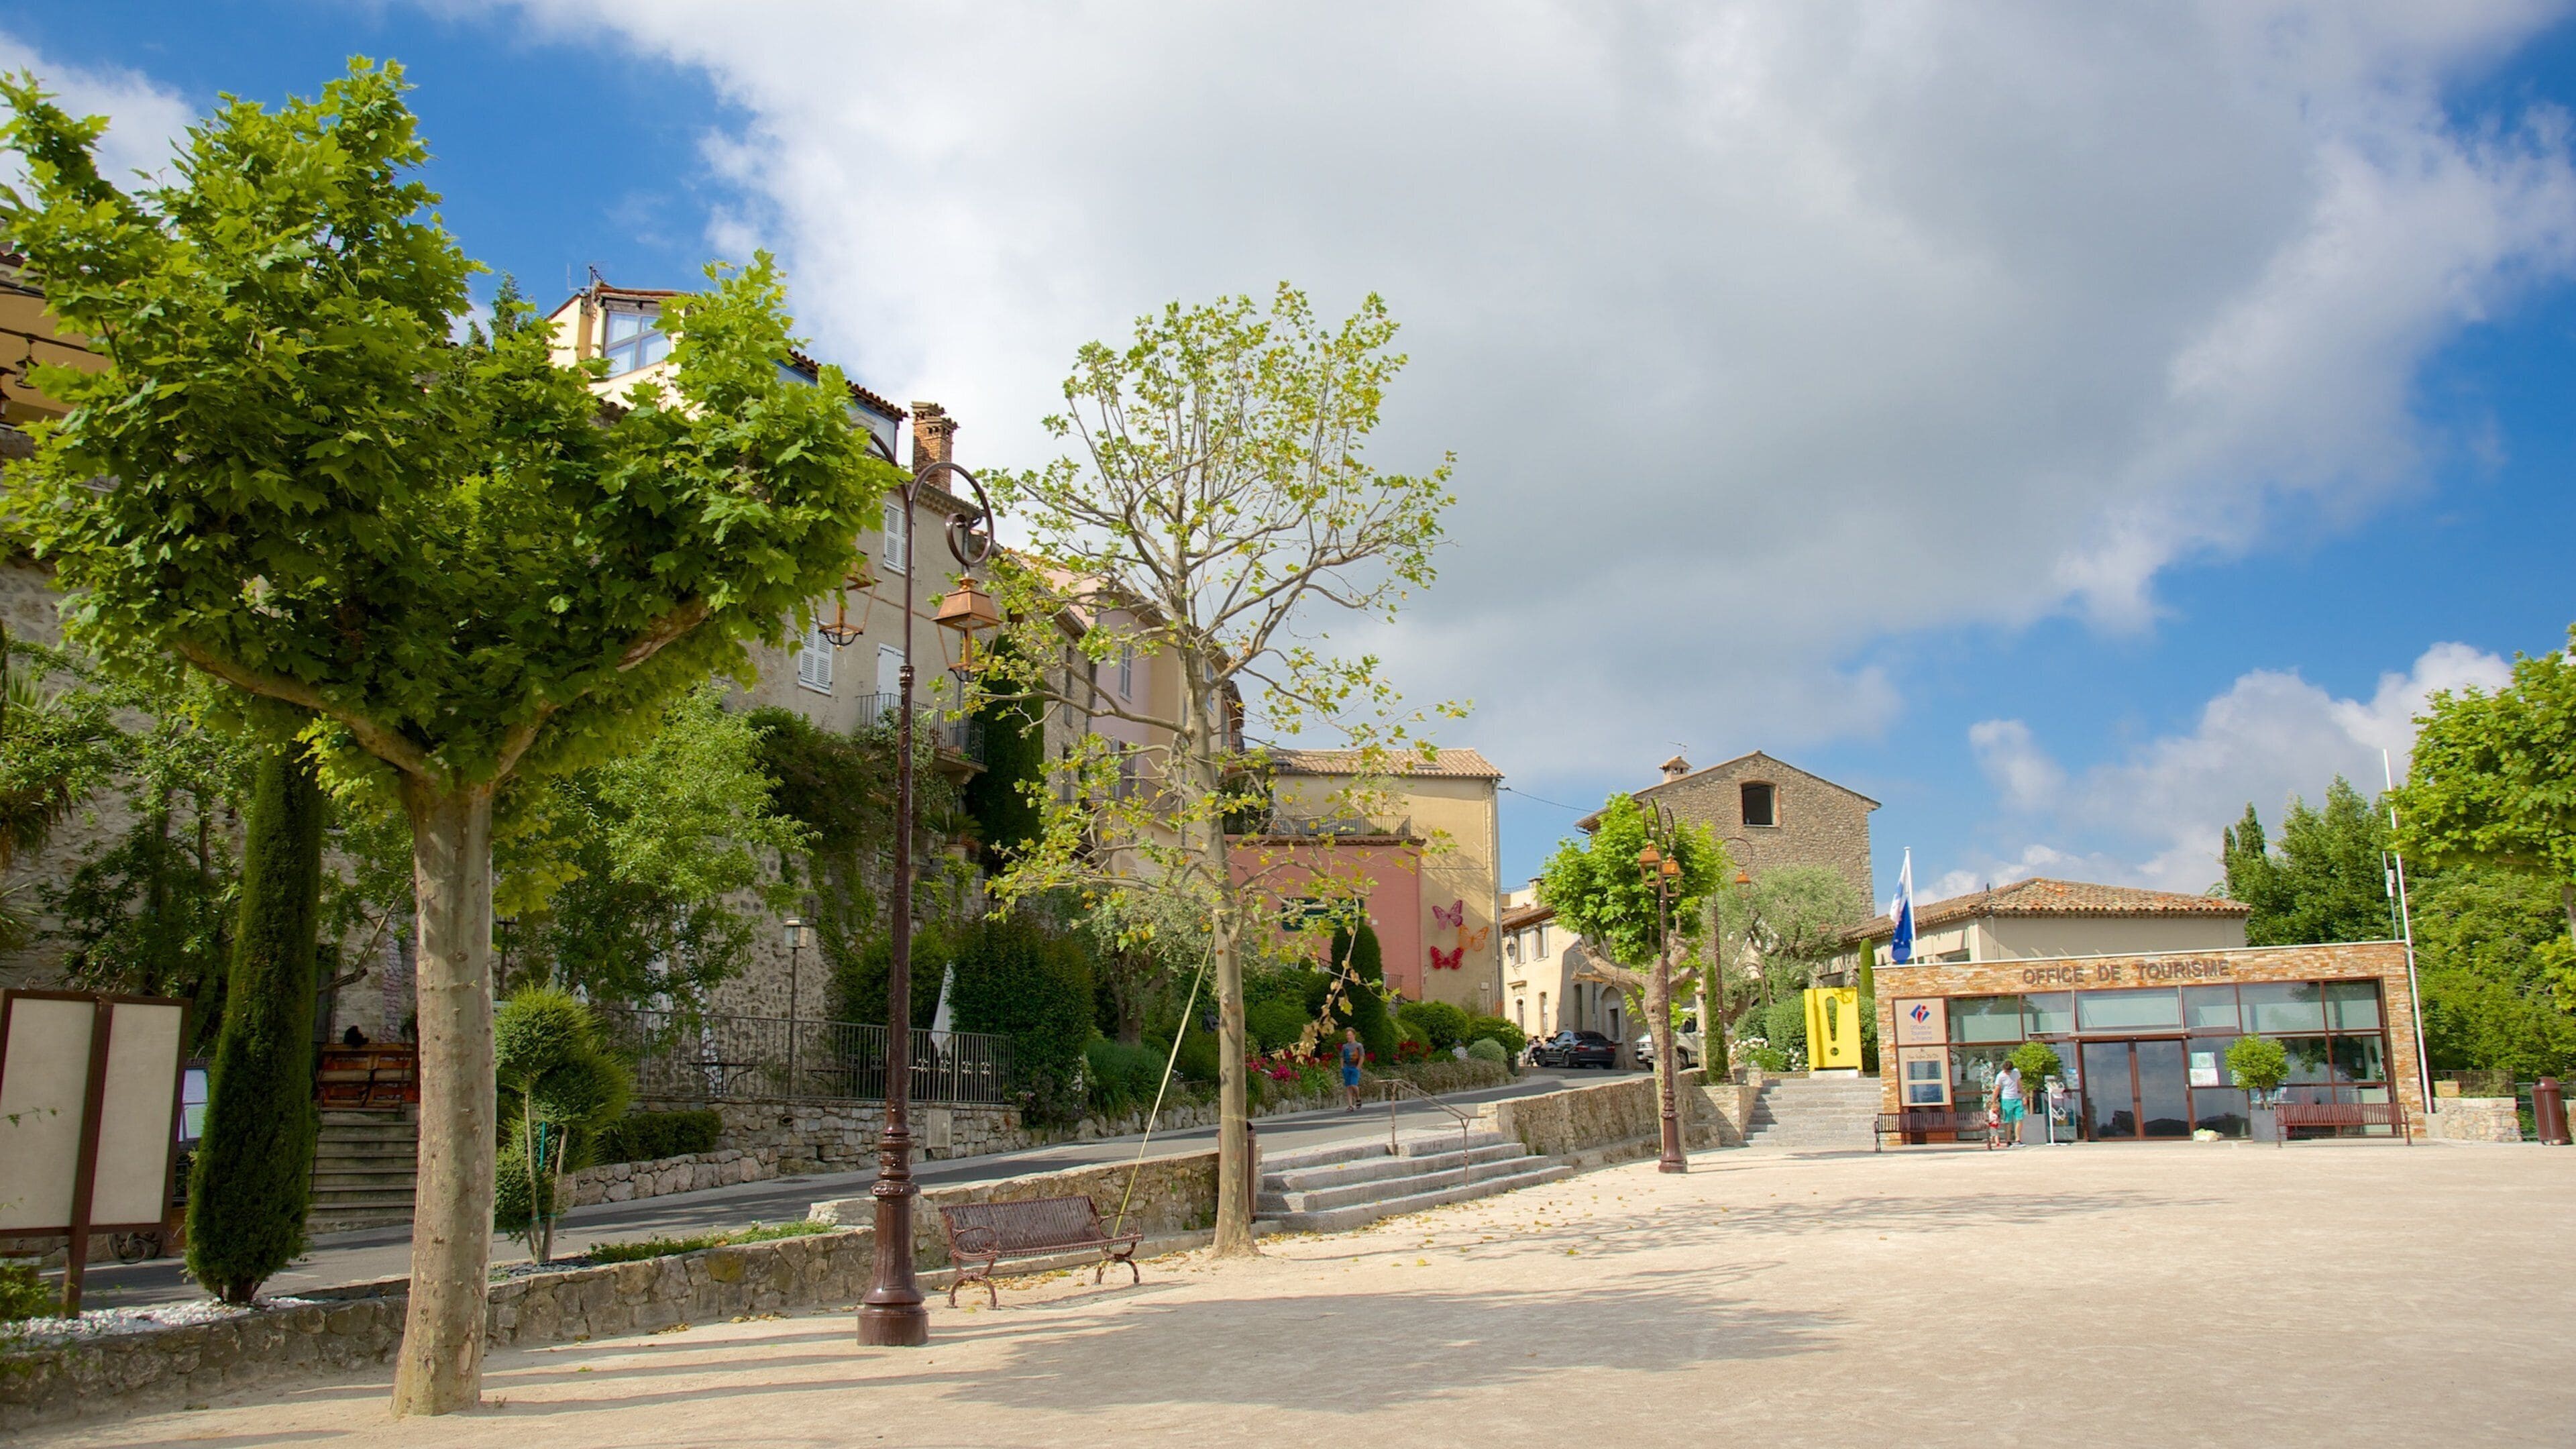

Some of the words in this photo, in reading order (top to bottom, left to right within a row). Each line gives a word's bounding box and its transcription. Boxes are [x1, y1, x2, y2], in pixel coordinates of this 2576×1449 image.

[2023, 966, 2084, 984] OFFICE
[2098, 965, 2121, 981] DE
[2136, 959, 2230, 979] TOURISME
